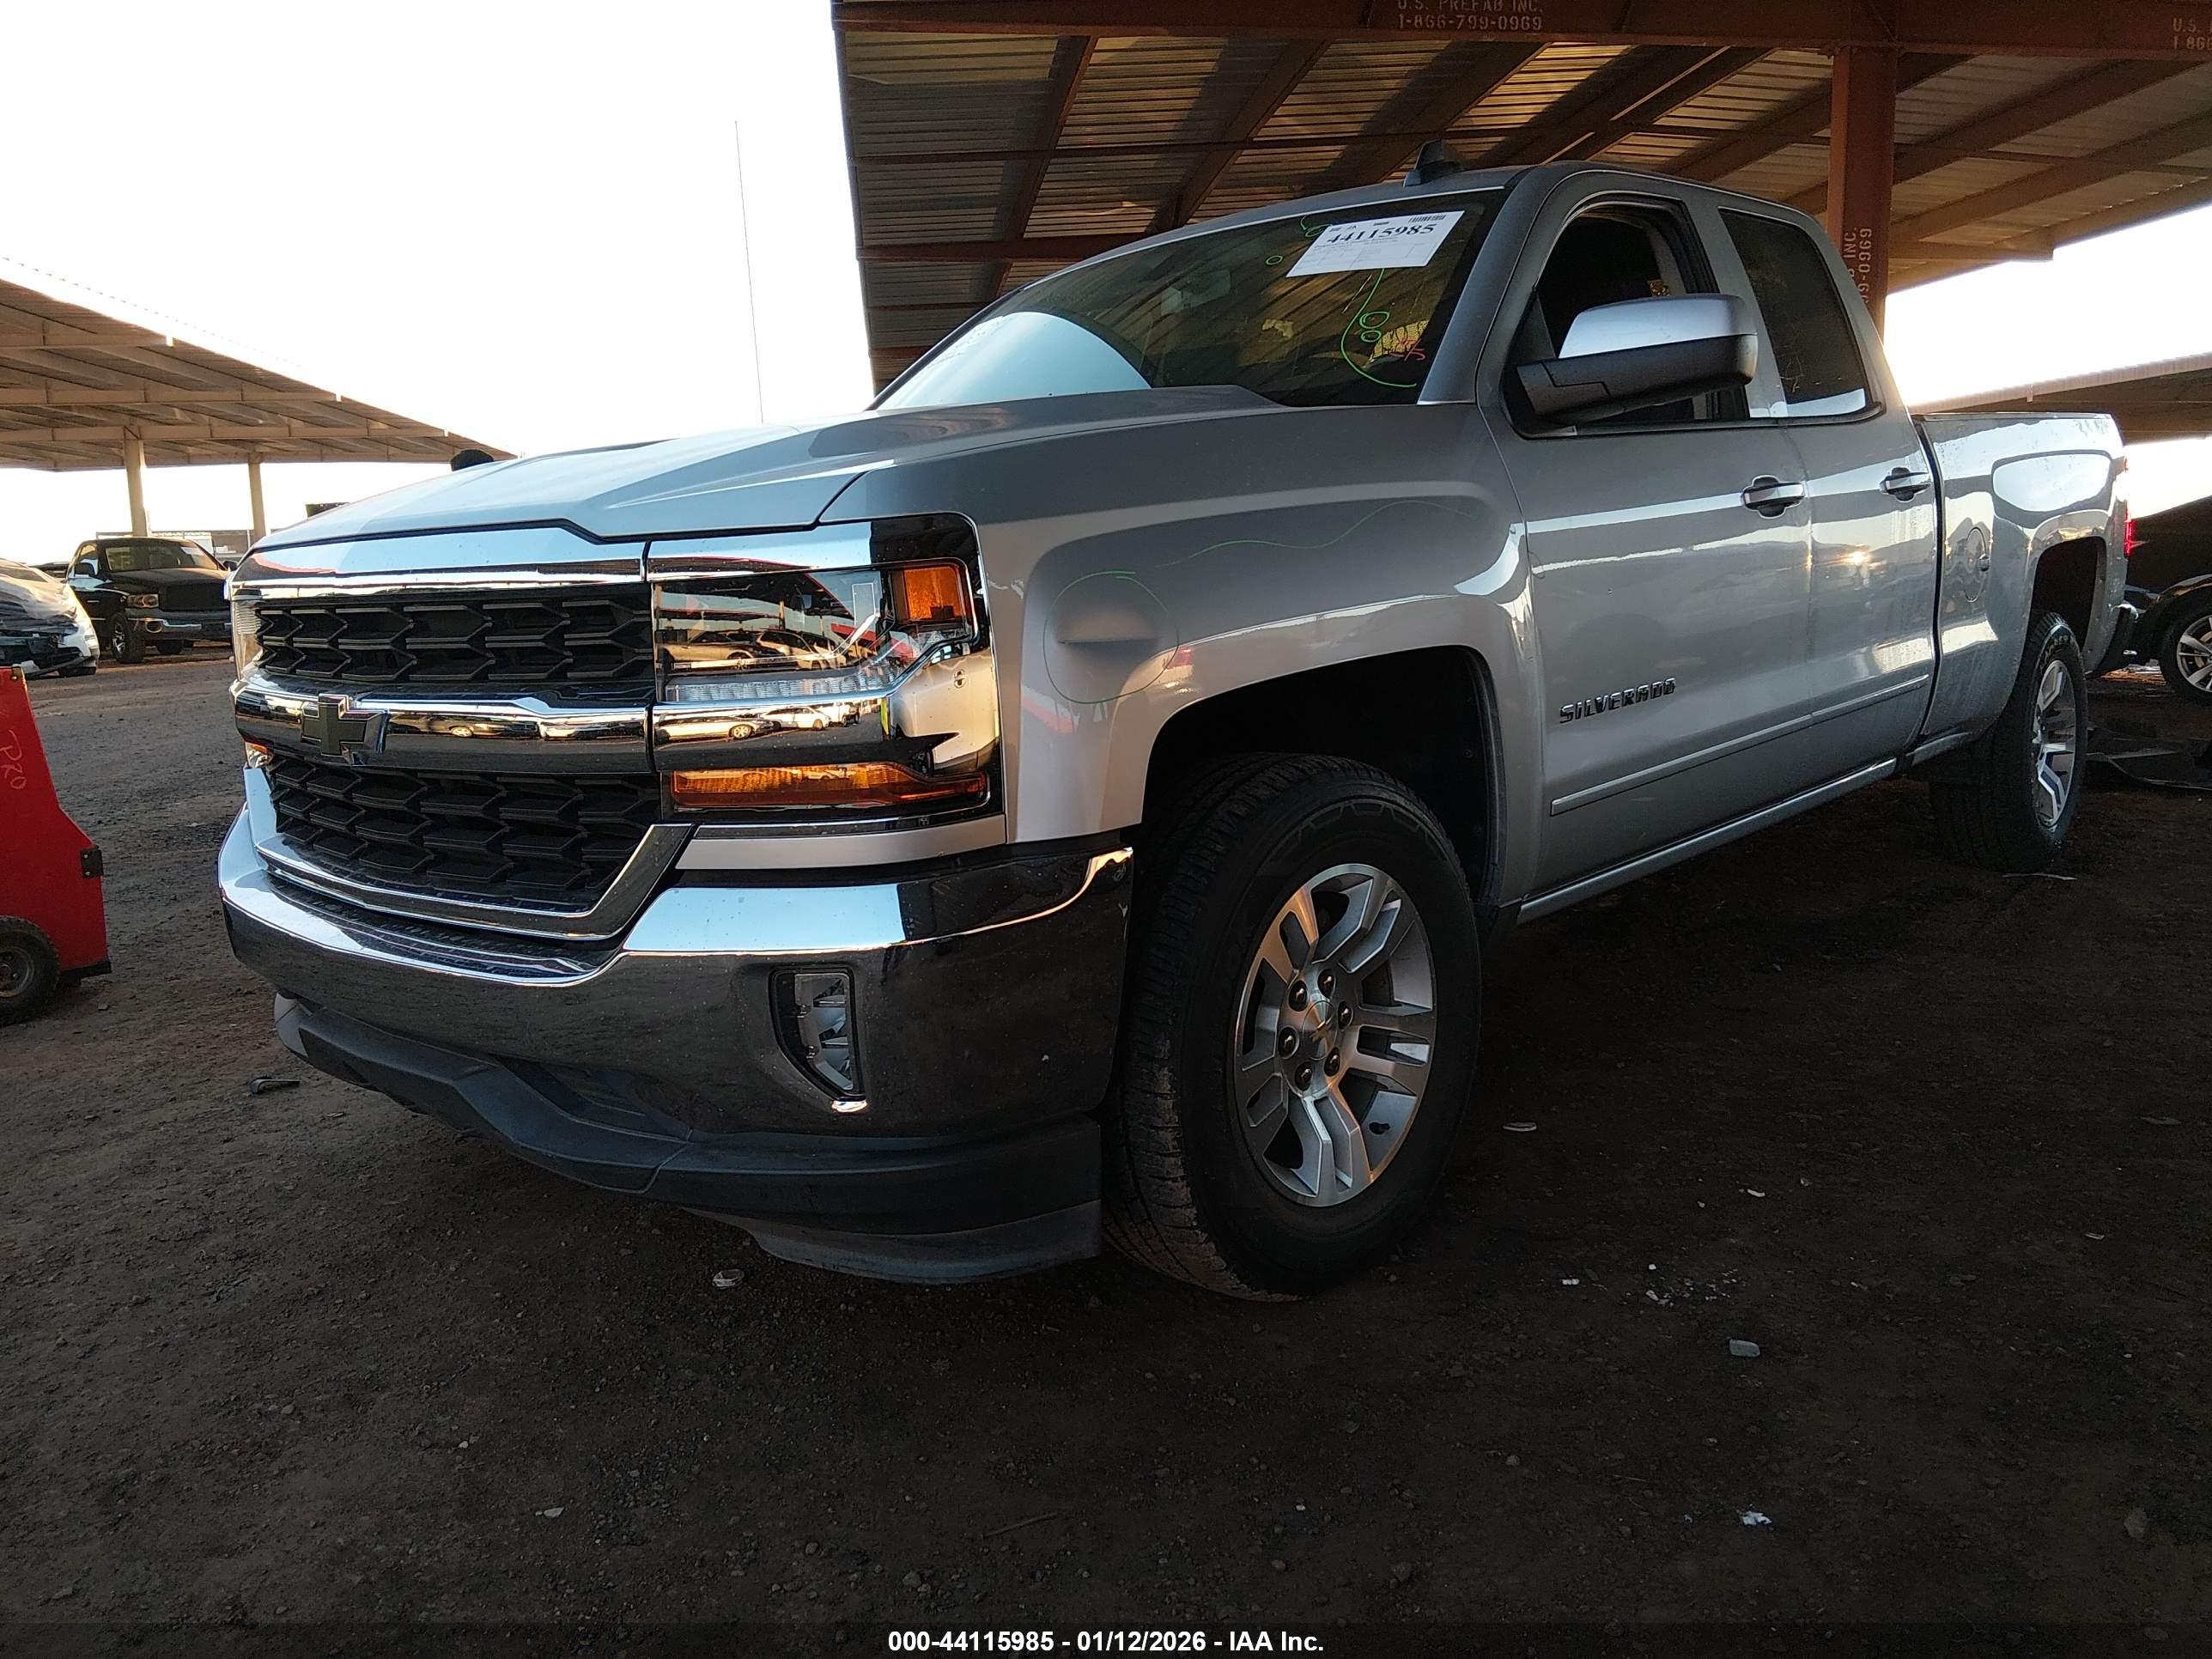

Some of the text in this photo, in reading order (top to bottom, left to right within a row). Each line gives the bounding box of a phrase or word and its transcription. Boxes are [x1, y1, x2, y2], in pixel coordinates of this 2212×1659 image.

[1398, 0, 1544, 13] U.S. PREFAB INC.
[1399, 14, 1543, 31] 1-866-799-0969
[1328, 223, 1437, 244] 44115985
[1843, 227, 1856, 258] INC.
[1559, 677, 1677, 724] SILVERADO
